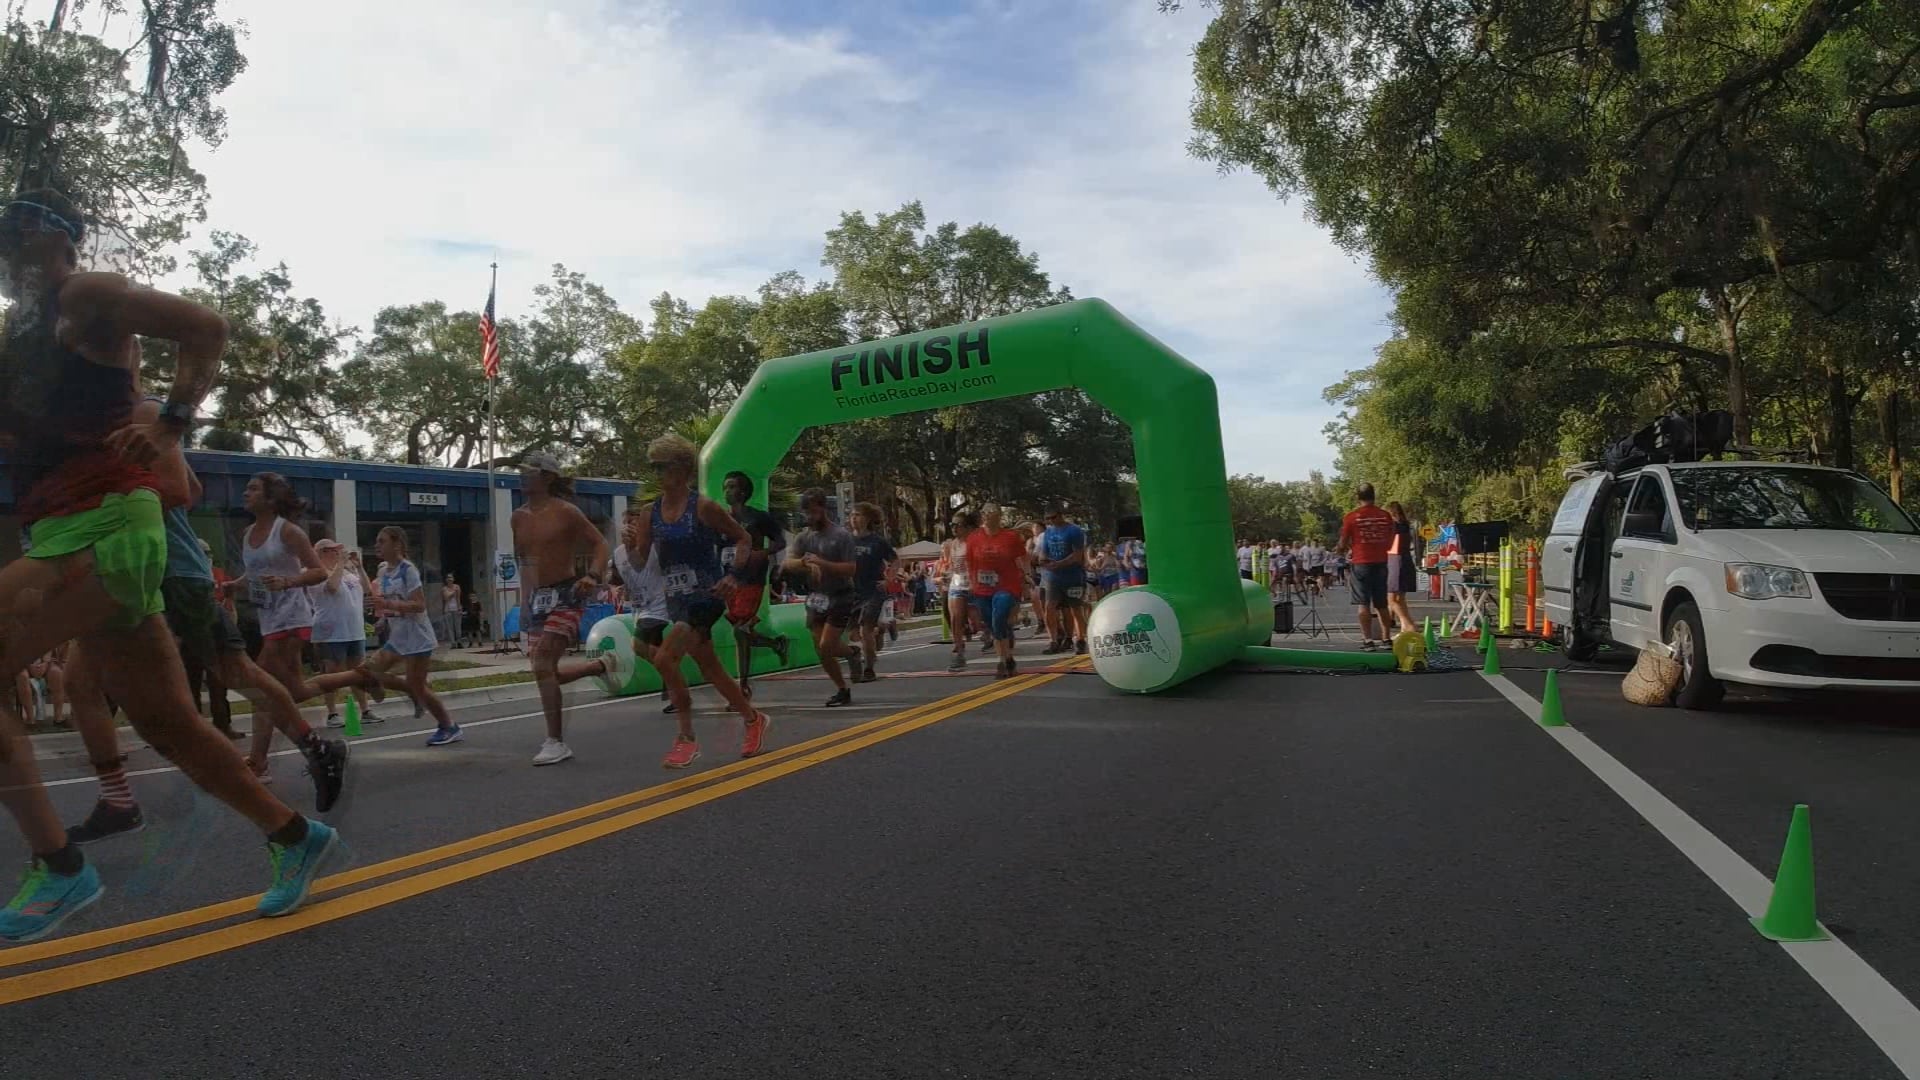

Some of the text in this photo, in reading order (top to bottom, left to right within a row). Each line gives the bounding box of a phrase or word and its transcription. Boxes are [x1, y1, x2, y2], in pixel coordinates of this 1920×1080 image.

[831, 327, 991, 391] FINISH
[836, 374, 997, 409] FloridaRaceDay.com
[418, 495, 438, 504] 555
[1092, 630, 1151, 648] FLORIDA
[1094, 642, 1151, 659] RACE DAY
